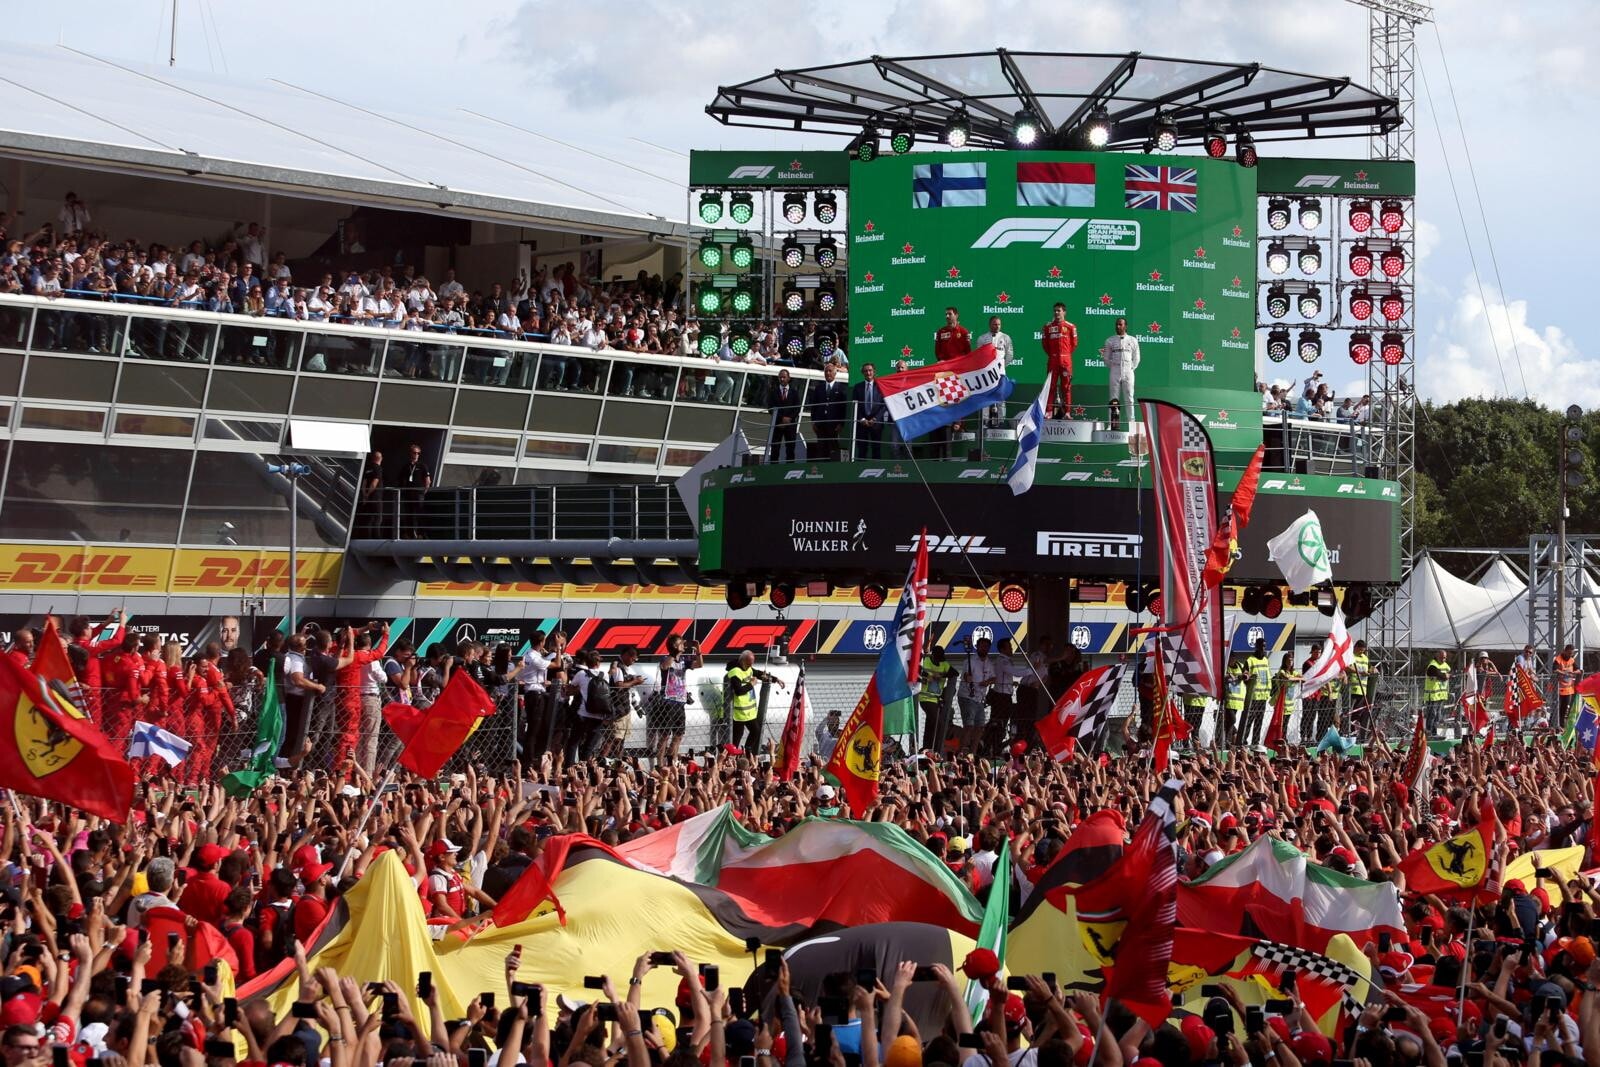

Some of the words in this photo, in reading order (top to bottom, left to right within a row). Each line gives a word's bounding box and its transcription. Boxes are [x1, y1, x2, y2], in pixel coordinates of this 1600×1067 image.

[777, 171, 814, 179] Heineken
[1343, 181, 1379, 190] Heineken
[855, 232, 885, 243] Heineken
[970, 218, 1089, 249] F1
[1223, 237, 1250, 248] Heineken
[891, 255, 926, 265] Heineken
[1183, 259, 1215, 270] Heineken
[855, 283, 884, 294] Heineken
[934, 279, 973, 289] Heineken
[1034, 279, 1075, 289] Heineken
[1136, 282, 1174, 292] Heineken
[1222, 288, 1250, 299] Heineken
[891, 306, 925, 316] Heineken
[983, 304, 1024, 314] Heineken
[1085, 306, 1126, 316] Heineken
[1182, 310, 1215, 321] Heineken
[854, 334, 884, 344] Heineken
[1135, 334, 1174, 344] Heineken
[1221, 339, 1249, 349] Heineken
[1182, 362, 1215, 372] Heineken
[904, 387, 936, 411] ČAP
[1043, 425, 1076, 437] ARBON
[789, 519, 849, 537] JOHNNIE
[792, 538, 849, 551] WALKER
[1037, 531, 1144, 558] PIRELLI
[9, 552, 134, 586] DHL
[195, 557, 309, 588] DHL
[595, 626, 661, 648] F1
[863, 626, 887, 649] FIA
[1072, 627, 1091, 648] FIA
